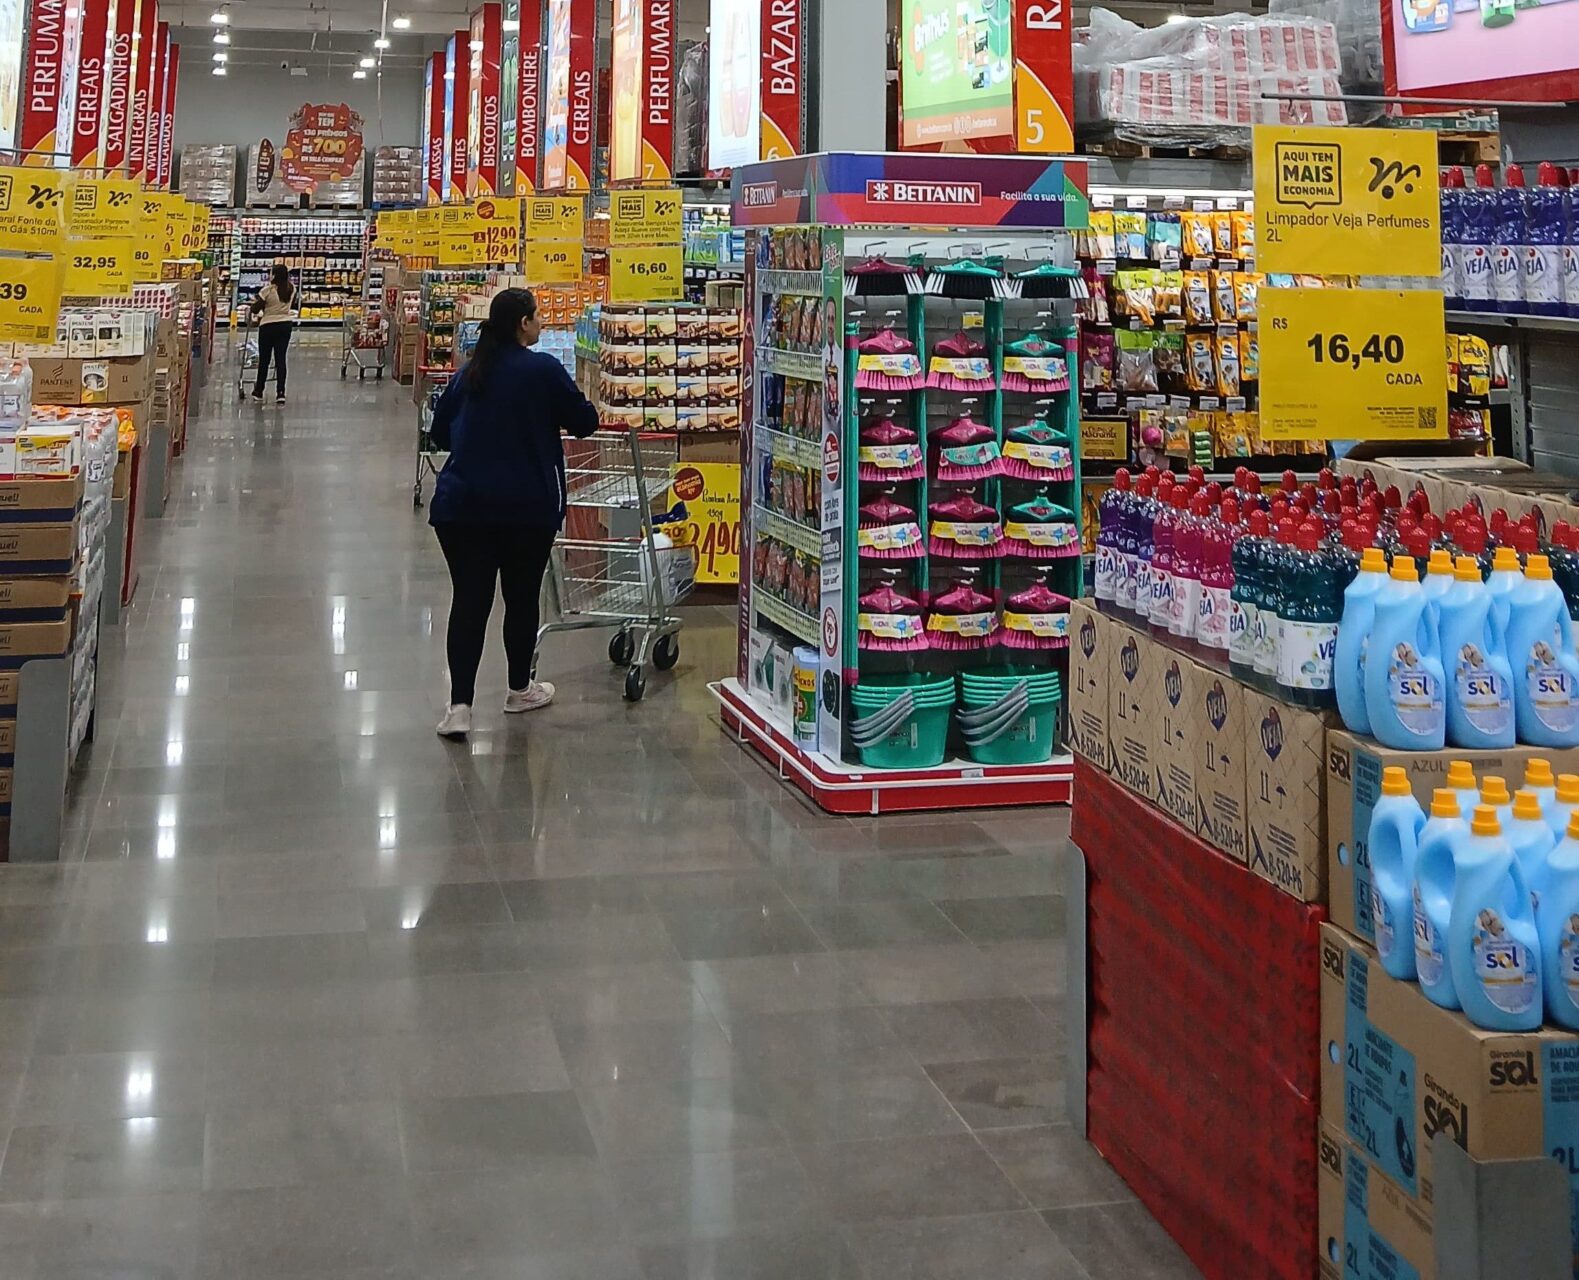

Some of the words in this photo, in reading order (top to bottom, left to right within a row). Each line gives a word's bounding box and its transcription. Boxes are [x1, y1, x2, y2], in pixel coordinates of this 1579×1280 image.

[77, 56, 102, 137] CEREAIS
[106, 32, 130, 153] SALGADINHOS
[520, 50, 538, 159] BOMBONIERE
[572, 70, 591, 145] CEREAIS
[129, 88, 147, 163] INTEGRAIS
[482, 94, 497, 168] BISCOITOS
[1026, 109, 1044, 146] 5
[313, 137, 347, 154] 700
[454, 137, 466, 175] LEITES
[432, 135, 443, 181] MASSAS
[1283, 152, 1308, 162] AQUI
[1312, 152, 1333, 162] TEM
[1283, 164, 1333, 183] MAIS
[750, 184, 776, 206] BETTANIN
[894, 184, 976, 203] BETTANIN
[1284, 186, 1334, 196] ECONOMIA
[1266, 211, 1329, 229] Limpador
[1332, 213, 1362, 231] Veja
[1367, 213, 1430, 229] Perfumes
[1266, 228, 1283, 242] 2L
[73, 256, 116, 271] 32,95
[629, 262, 667, 276] 16,60
[1465, 255, 1492, 275] VEJA
[1272, 318, 1288, 331] R$
[1307, 333, 1404, 370] 16,40
[40, 378, 73, 386] PANTENE
[1386, 373, 1422, 385] CADA
[1400, 675, 1428, 696] sol
[1467, 675, 1496, 696] sol
[1538, 673, 1566, 693] sol
[1412, 759, 1444, 772] AZUL
[1486, 946, 1519, 970] sol
[1347, 1042, 1362, 1075] 2L
[1489, 1051, 1538, 1087] sol
